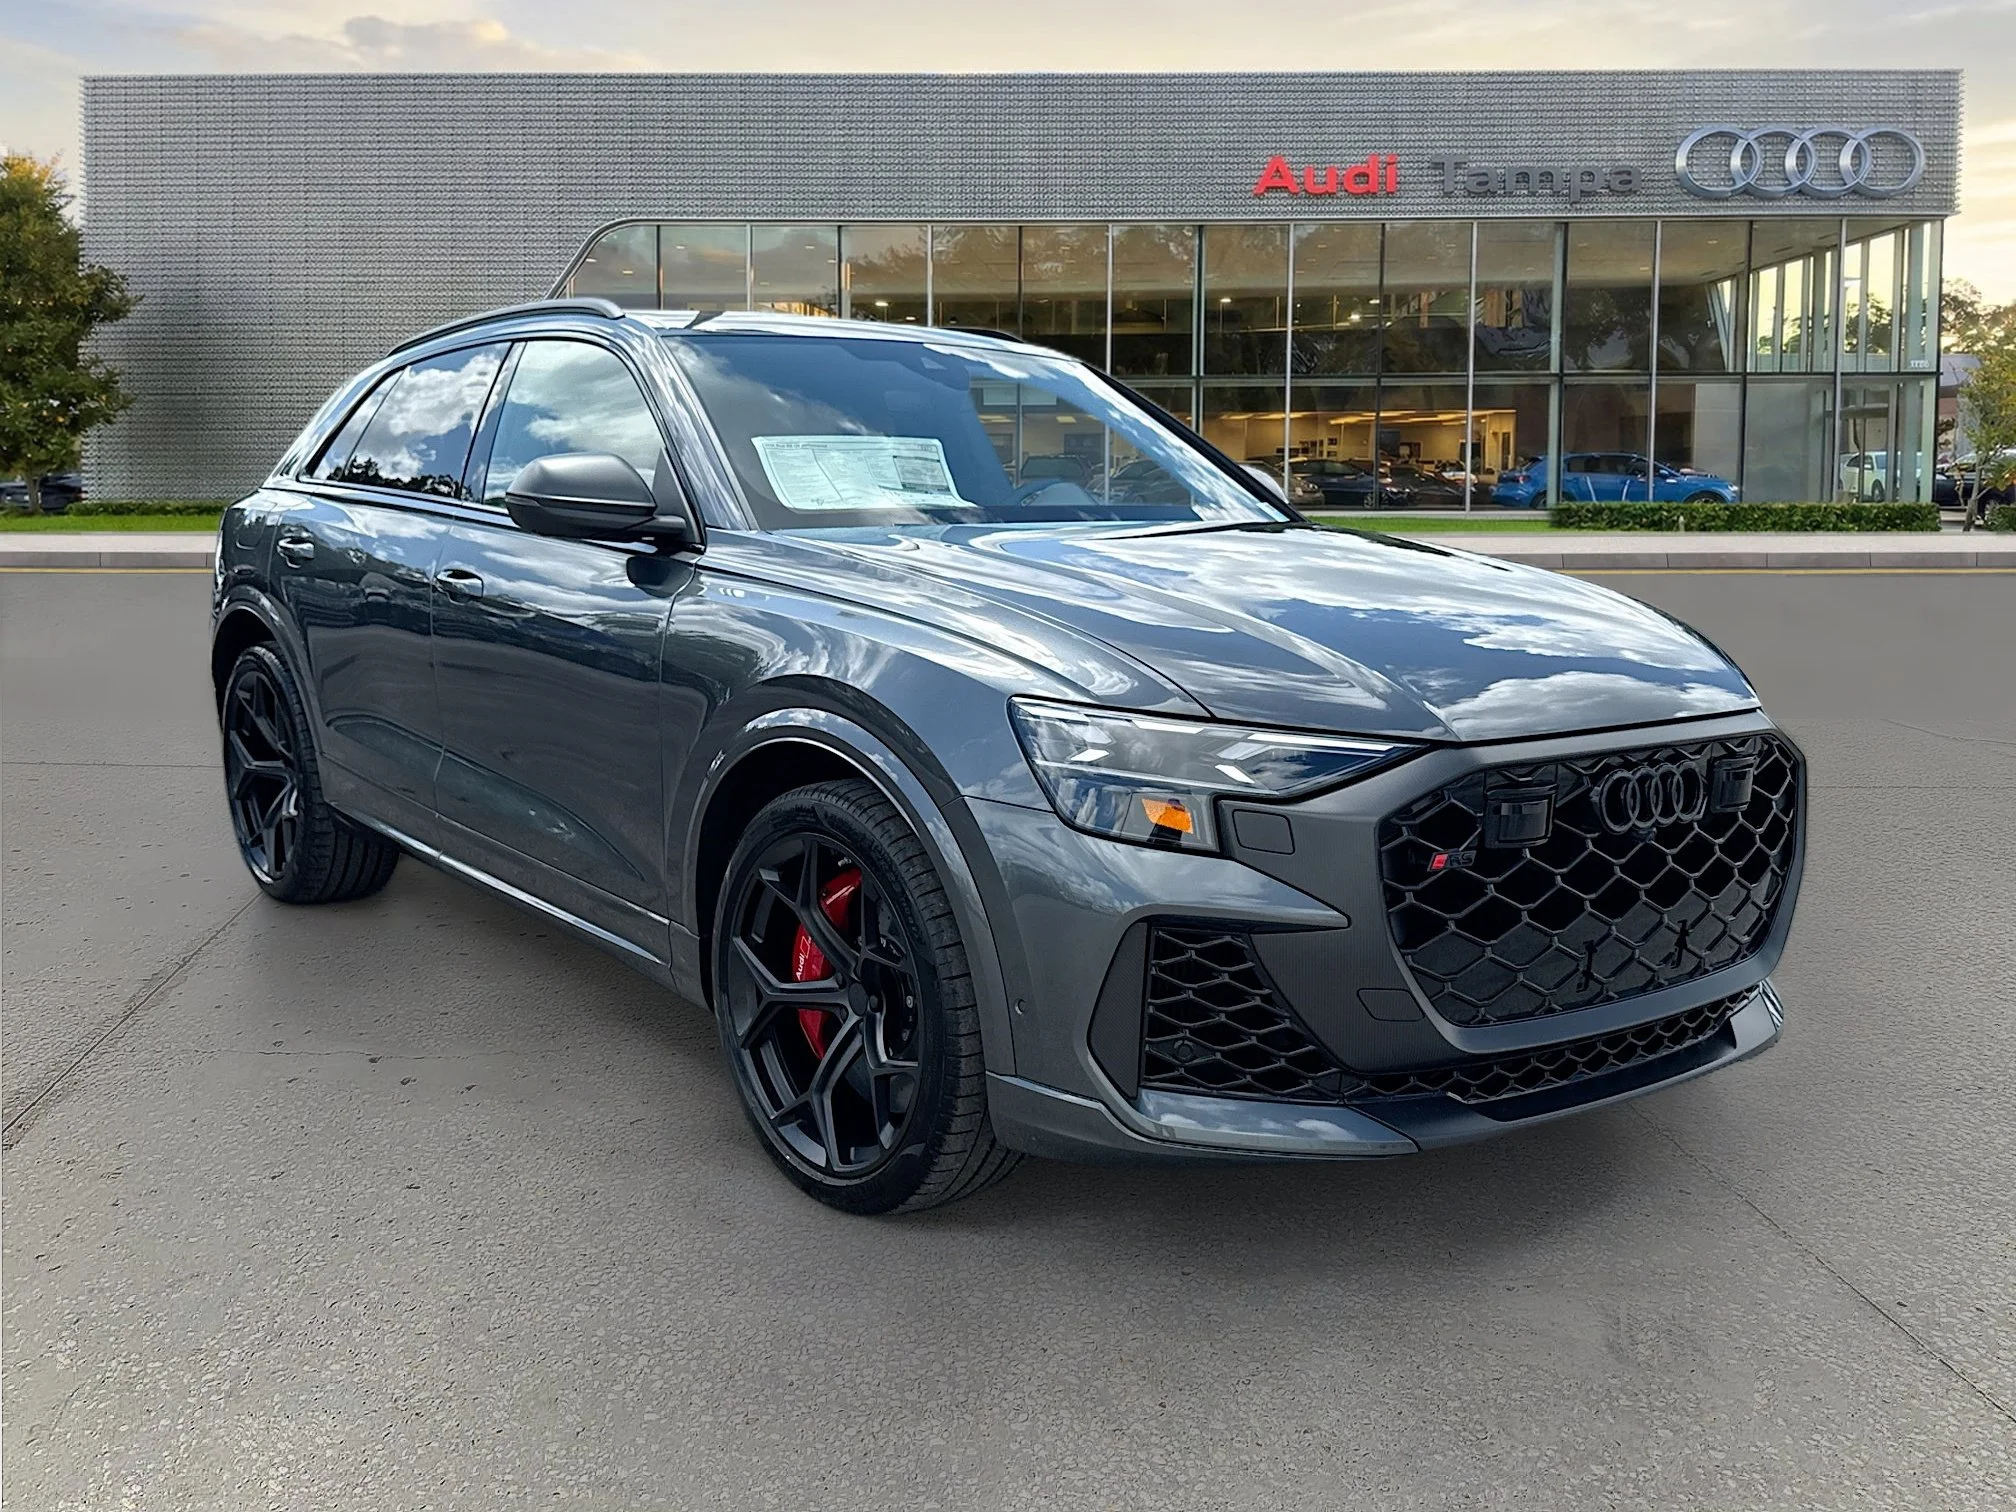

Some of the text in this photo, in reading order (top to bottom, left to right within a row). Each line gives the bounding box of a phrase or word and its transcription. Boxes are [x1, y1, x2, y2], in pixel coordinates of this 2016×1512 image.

[1253, 153, 1643, 201] Audi Tampa
[1449, 851, 1475, 867] RS
[796, 952, 805, 981] Audi
